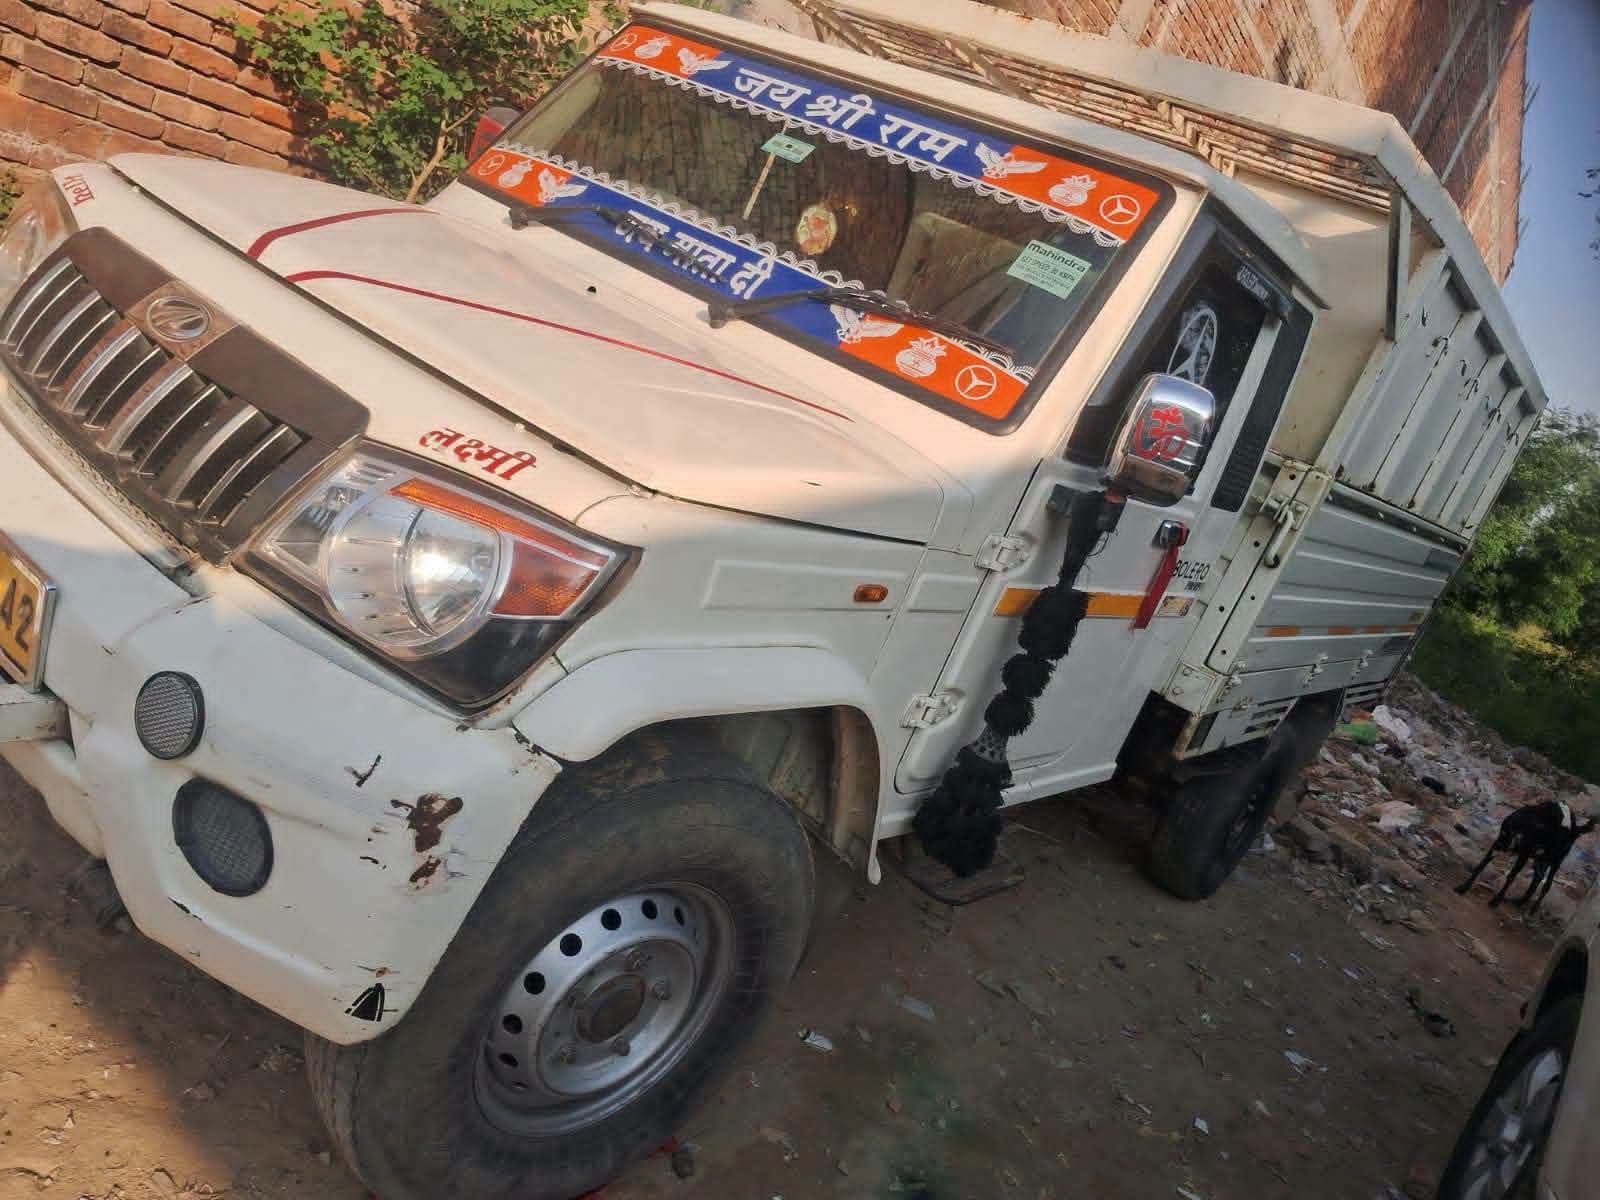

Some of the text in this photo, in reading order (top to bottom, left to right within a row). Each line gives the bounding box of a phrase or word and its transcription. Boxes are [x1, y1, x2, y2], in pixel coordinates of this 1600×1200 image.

[735, 68, 968, 162] जय श्री राम
[1028, 243, 1086, 272] mahindra
[730, 256, 777, 300] दी
[1172, 559, 1210, 581] BOLERO
